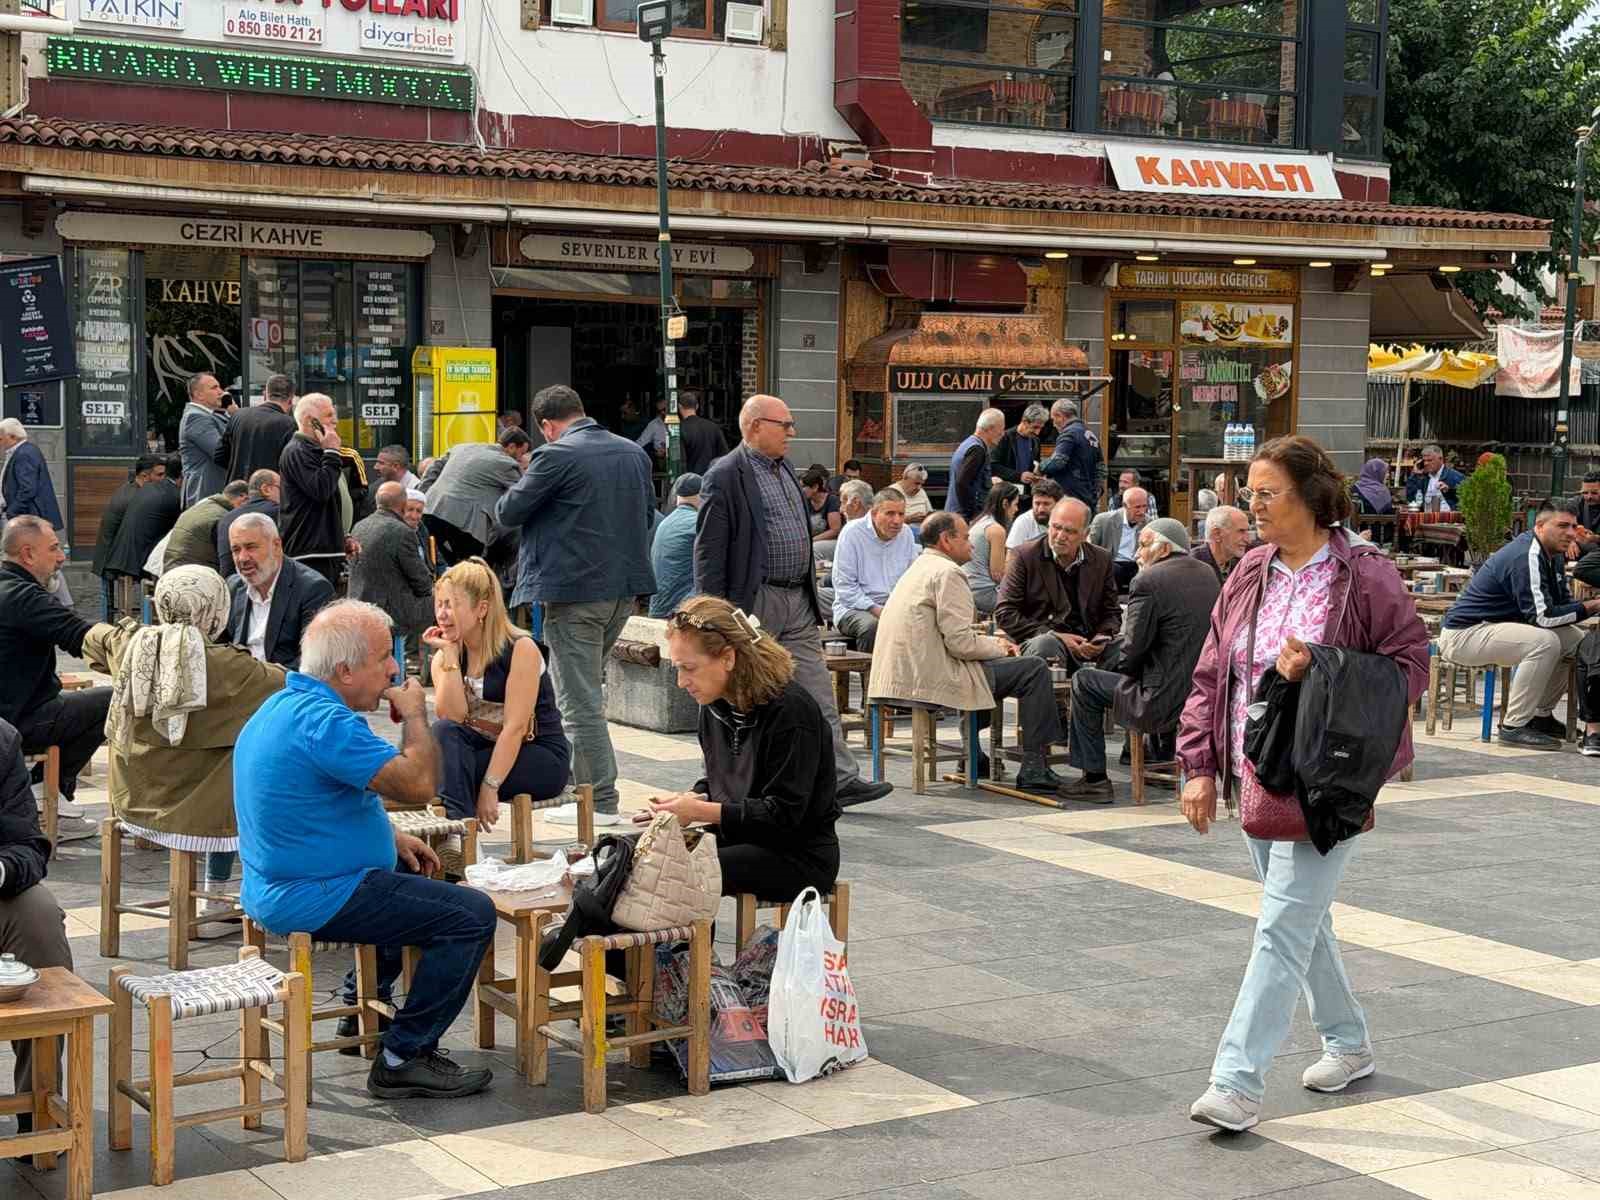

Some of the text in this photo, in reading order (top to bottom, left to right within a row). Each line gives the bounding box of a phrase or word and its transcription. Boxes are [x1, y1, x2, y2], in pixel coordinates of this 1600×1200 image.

[87, 11, 178, 27] TOURISM
[239, 10, 257, 21] Alo
[260, 11, 283, 24] Bilet
[227, 19, 322, 41] 0 850 850 21 21
[363, 21, 454, 47] diyarbilet
[216, 60, 325, 91] WHITE
[1135, 155, 1314, 193] KAHVALTI
[180, 222, 323, 246] CEZRİ KAHVE
[561, 242, 716, 264] SEVENLER ÇY EVİ
[161, 279, 242, 305] KAHVE
[896, 371, 933, 390] ULU
[939, 370, 993, 391] CAMİİ
[85, 403, 122, 415] SELF
[364, 406, 397, 417] SELF
[85, 416, 122, 425] SERVICE
